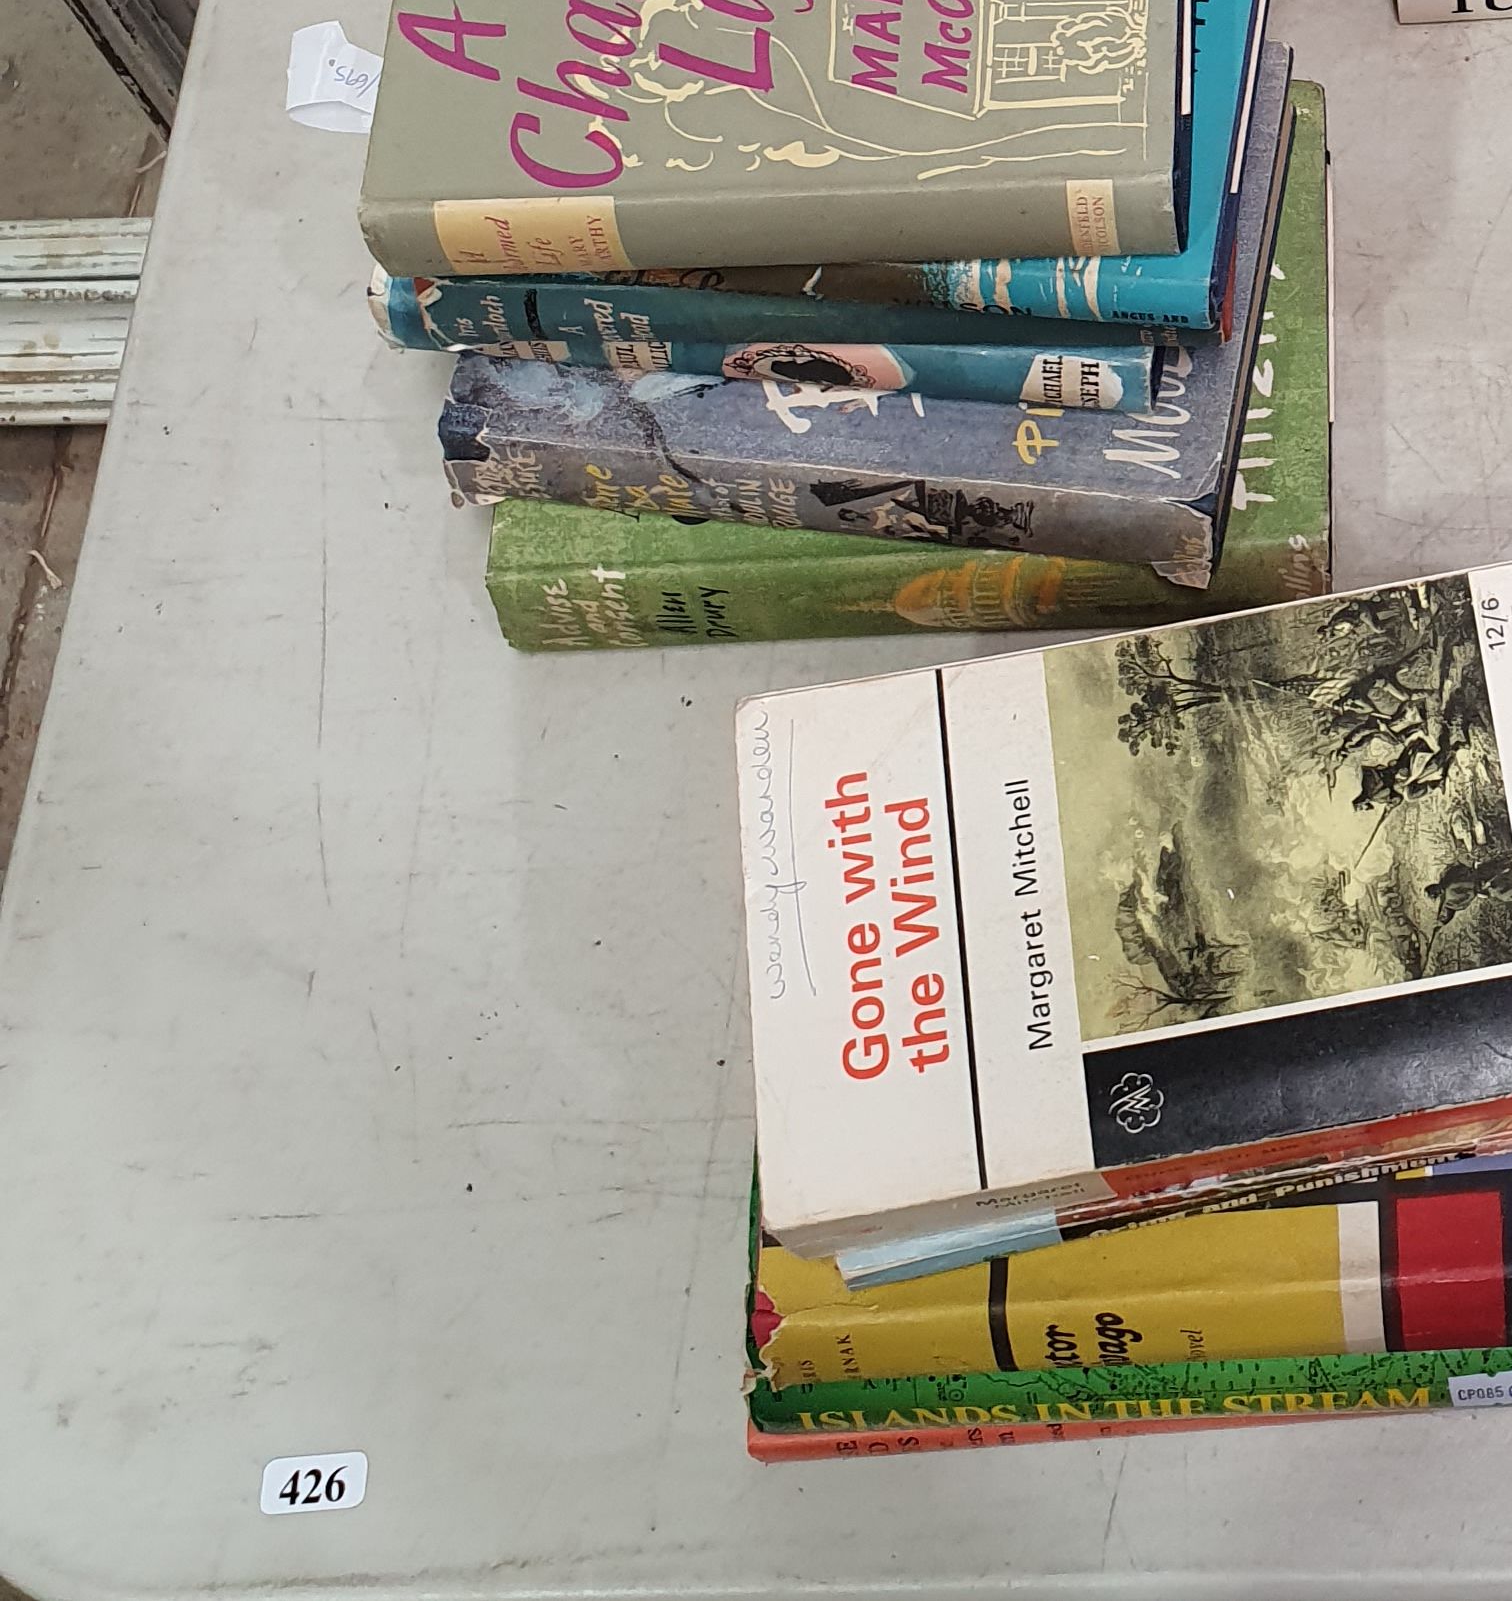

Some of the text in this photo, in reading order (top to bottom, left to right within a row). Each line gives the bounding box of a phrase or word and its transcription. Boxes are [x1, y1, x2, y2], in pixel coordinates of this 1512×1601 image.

[697, 586, 740, 640] Drury
[1479, 595, 1501, 652] 12/6
[824, 770, 892, 1082] Gone with
[884, 796, 951, 1075] the Wind
[1003, 776, 1055, 1052] Margaret Mitchell
[796, 1386, 1430, 1431] ISLANDS IN THE STREAM
[278, 1465, 349, 1506] 426
